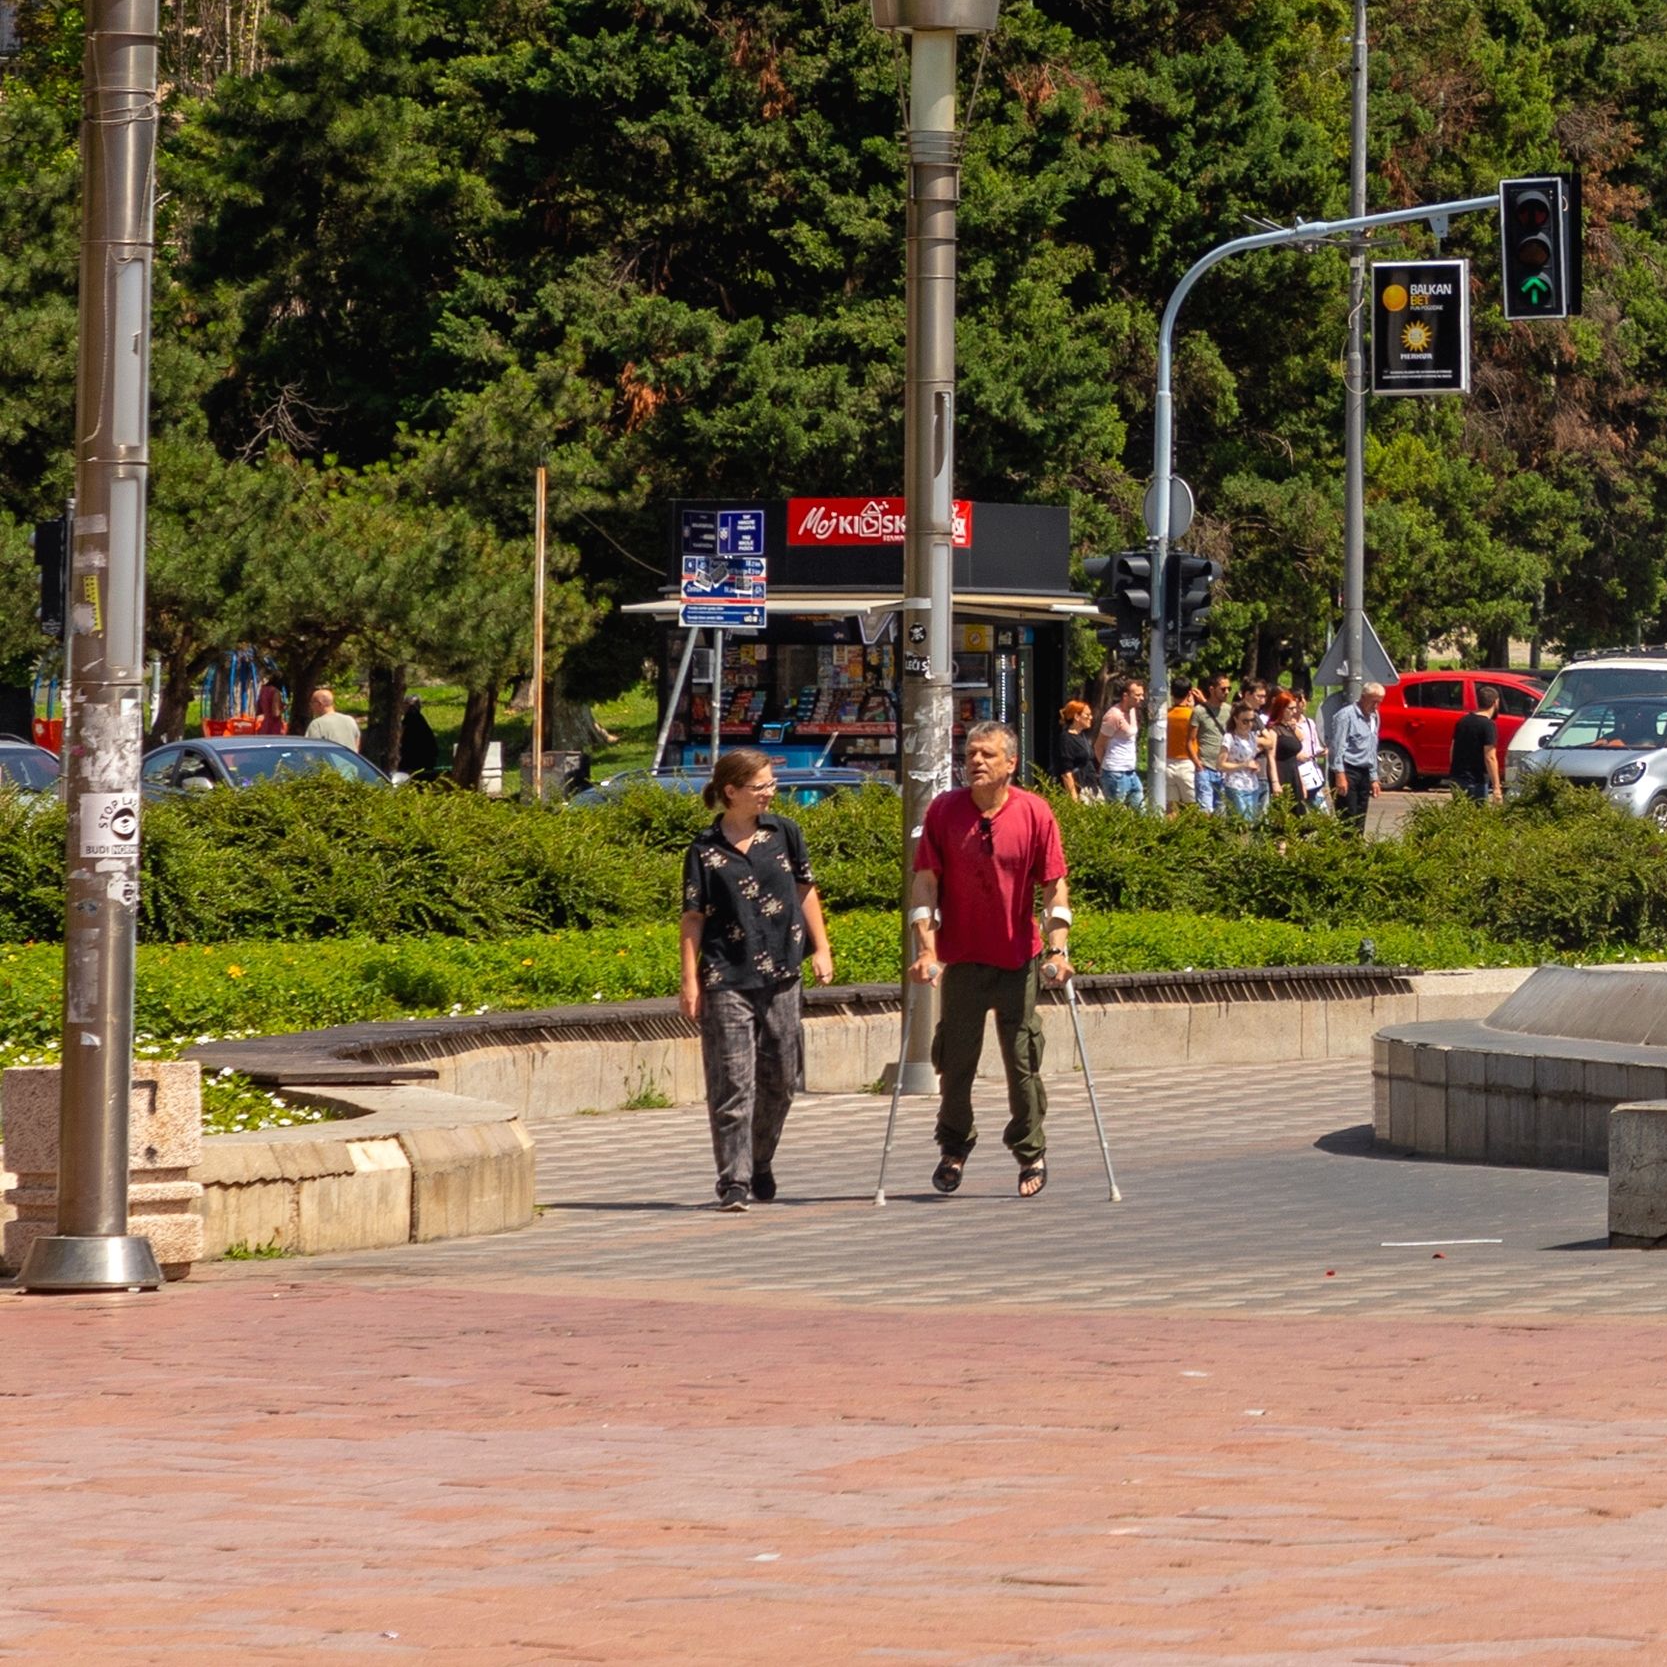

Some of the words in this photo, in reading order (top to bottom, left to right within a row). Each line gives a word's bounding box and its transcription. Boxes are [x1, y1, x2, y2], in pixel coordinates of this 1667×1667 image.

[1410, 283, 1452, 295] BALKAN
[1410, 294, 1430, 305] BET
[798, 506, 836, 540] Moj
[98, 800, 119, 829] STOP
[86, 845, 110, 854] BUDI
